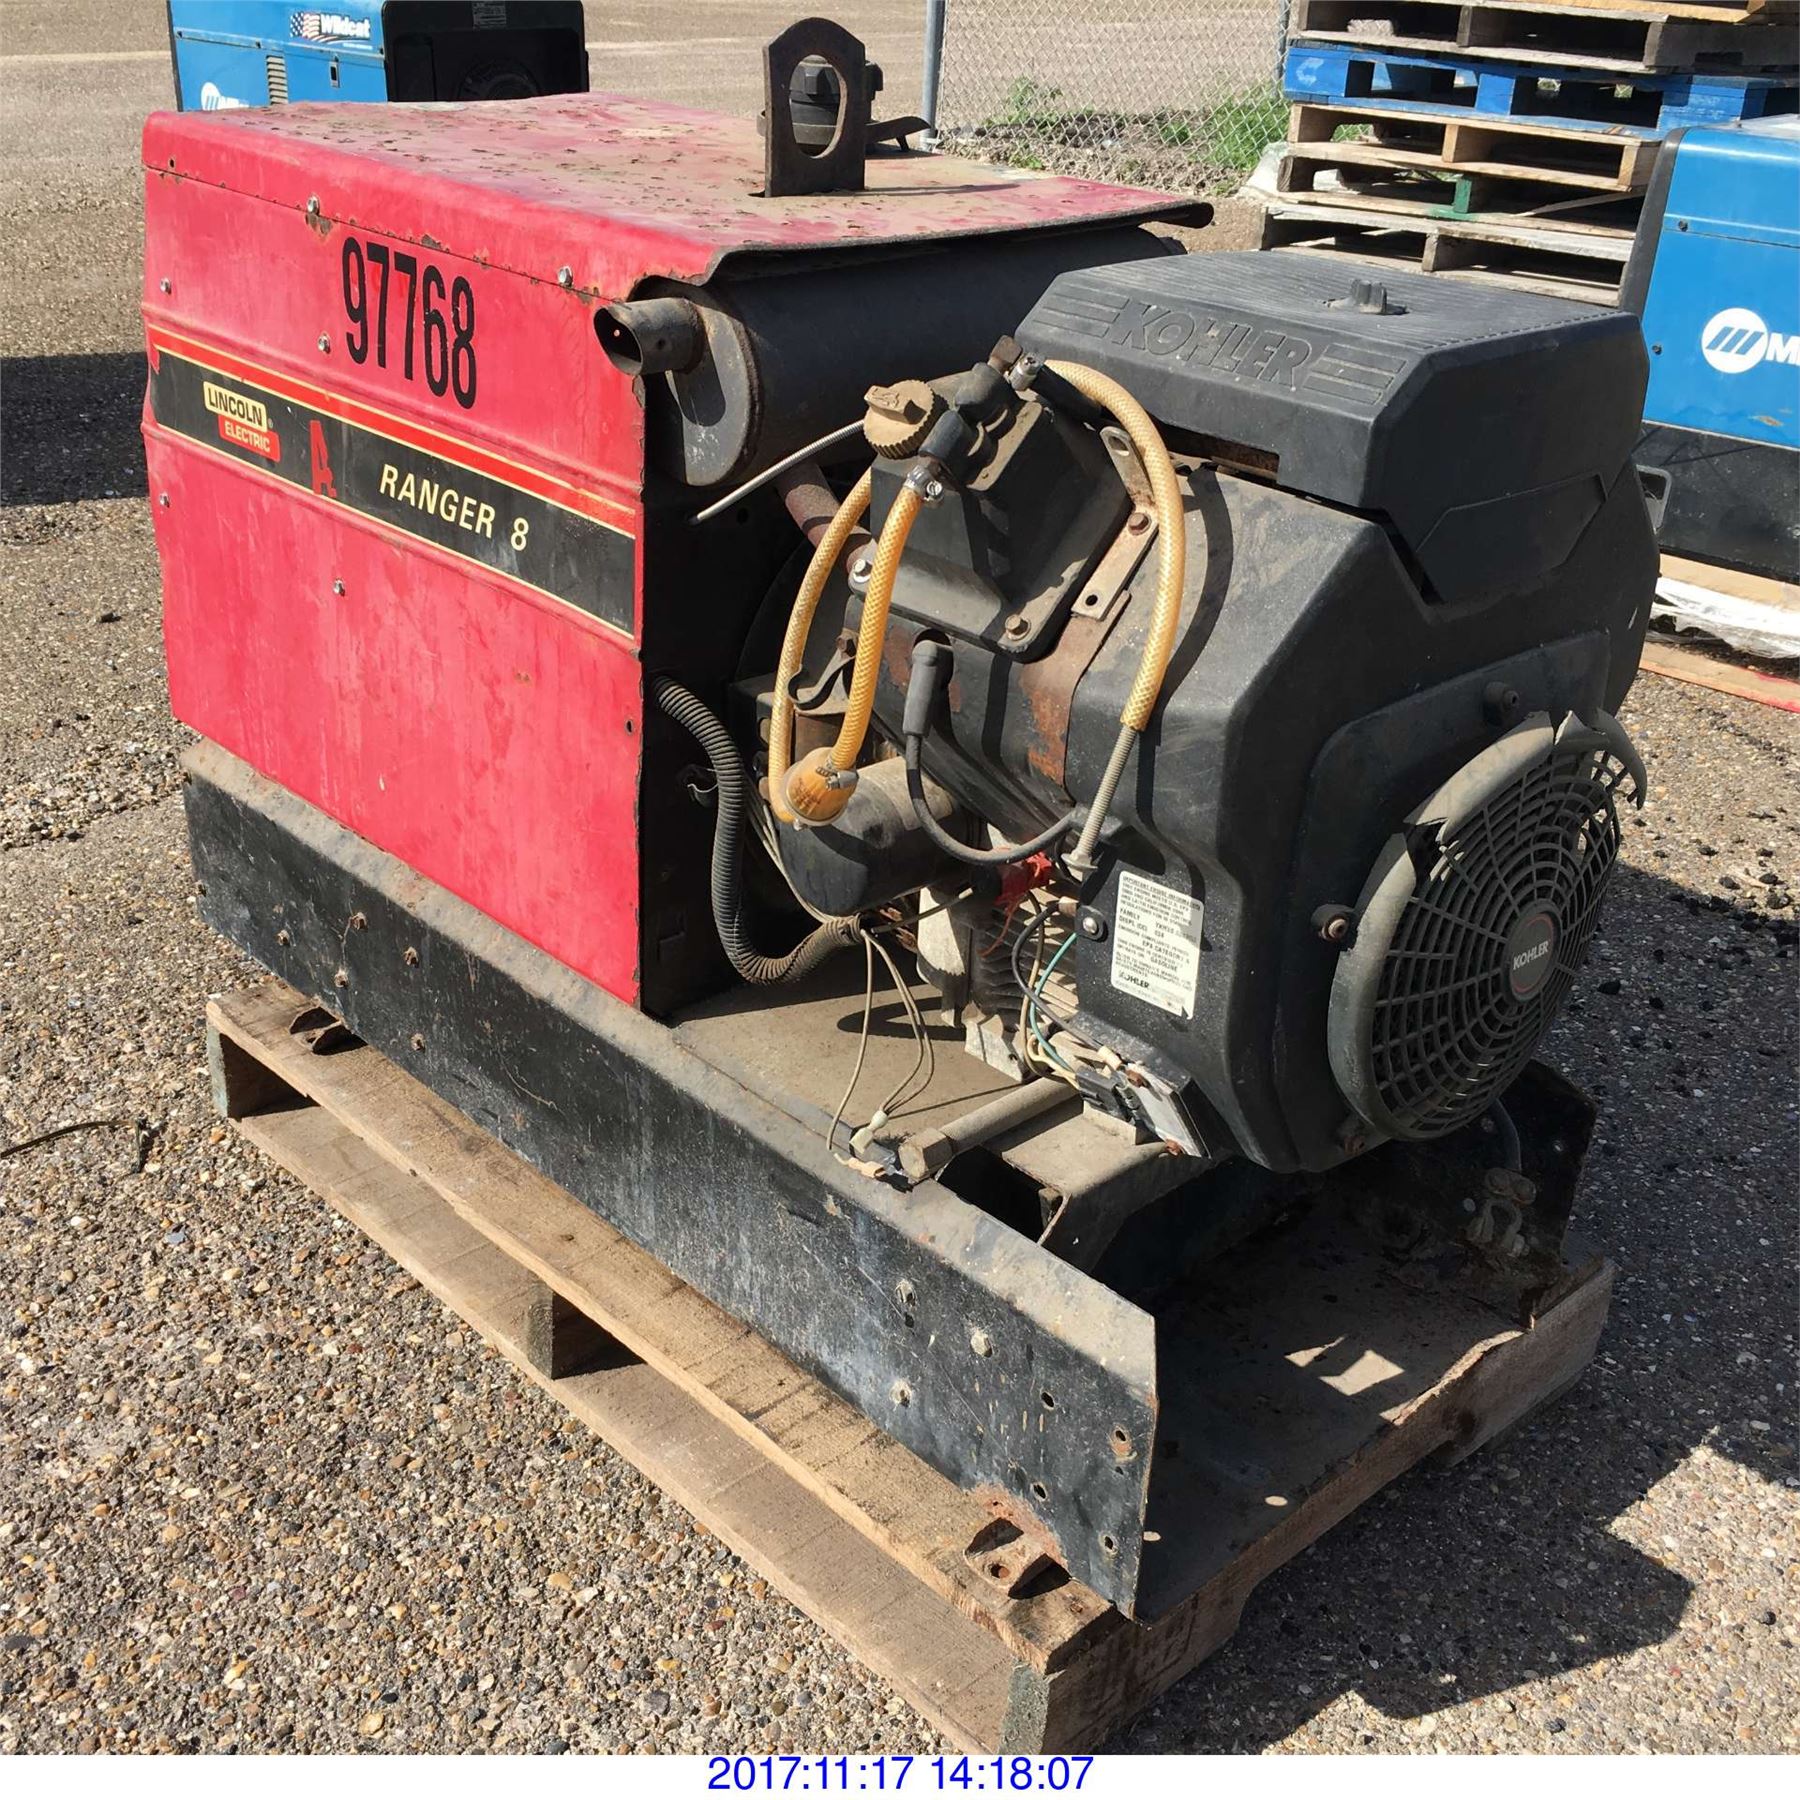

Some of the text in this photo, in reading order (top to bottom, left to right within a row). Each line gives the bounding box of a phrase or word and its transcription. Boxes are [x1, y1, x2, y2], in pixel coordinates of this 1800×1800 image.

[320, 13, 371, 39] Wildcat
[342, 236, 477, 409] 97768
[1112, 302, 1312, 388] KOHLER
[1766, 332, 1800, 367] M
[208, 387, 262, 427] LINCOLN
[224, 420, 271, 453] ELECTRIC
[380, 463, 530, 551] RANGER 8
[1513, 940, 1549, 970] KOHLER
